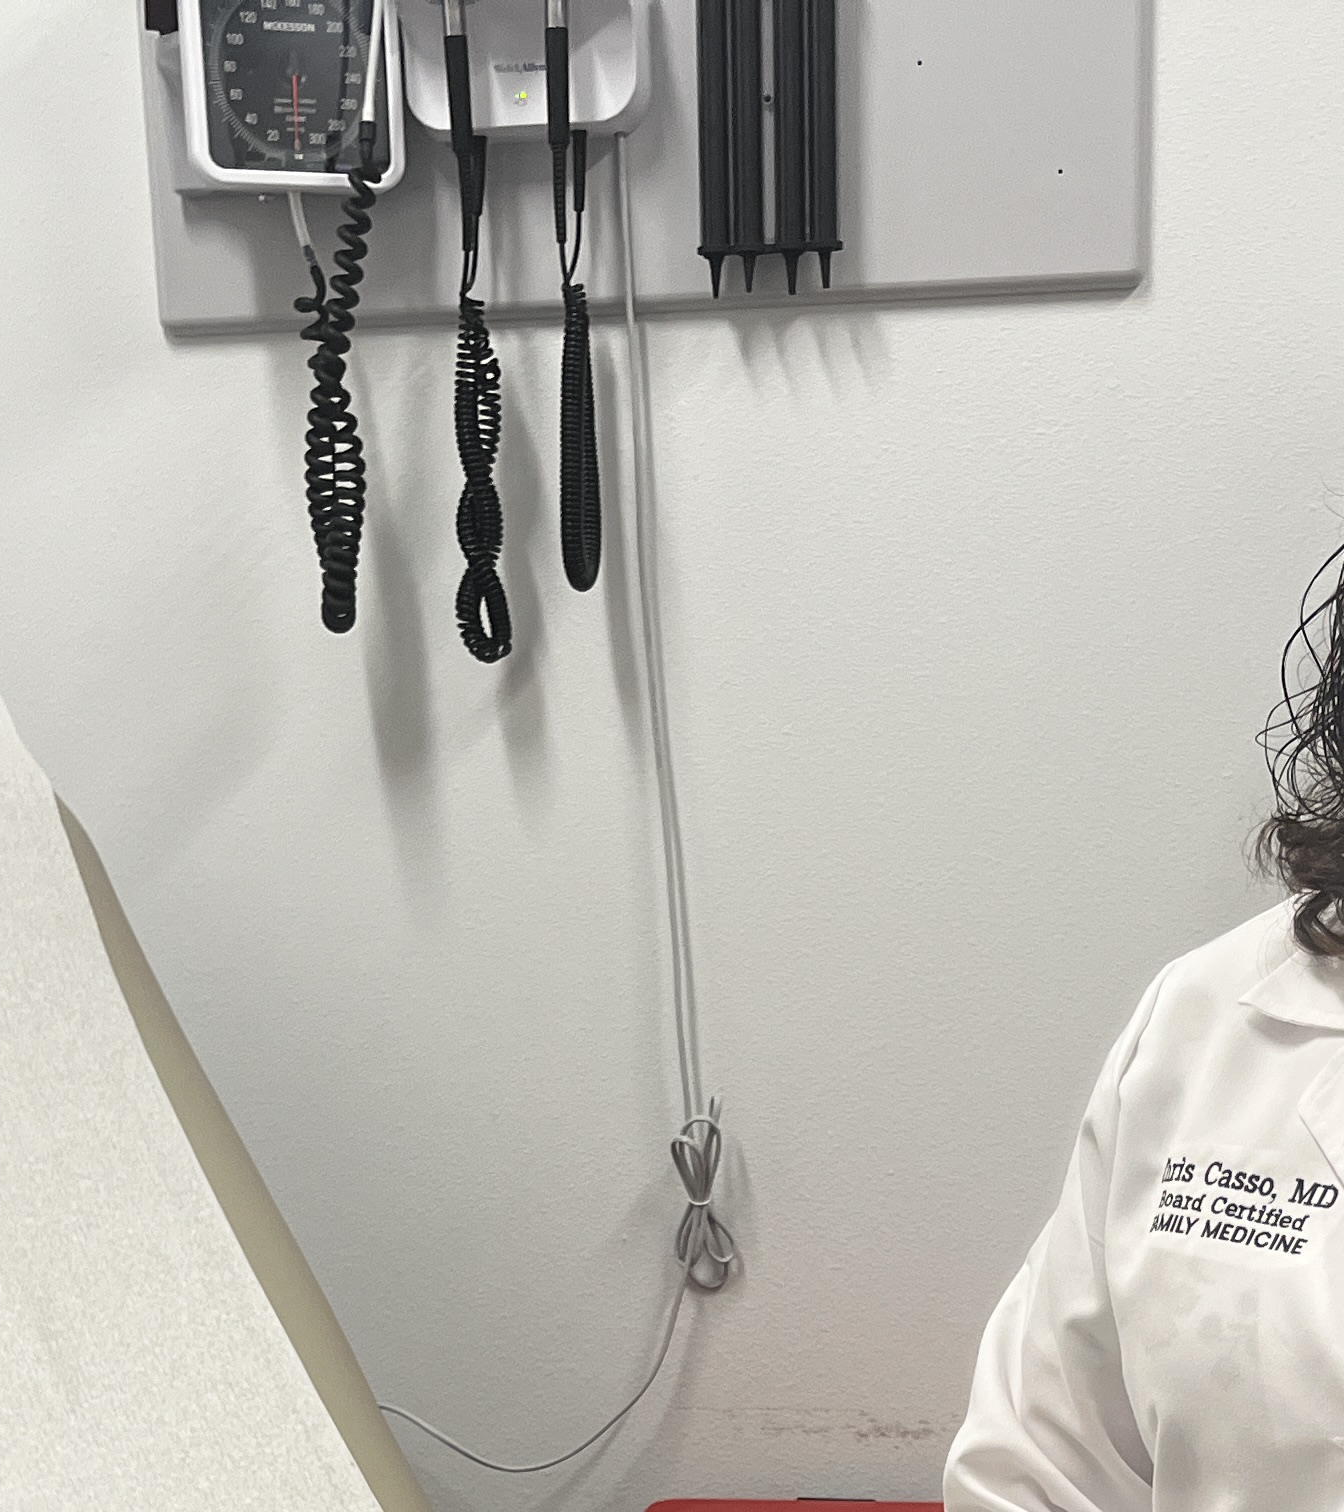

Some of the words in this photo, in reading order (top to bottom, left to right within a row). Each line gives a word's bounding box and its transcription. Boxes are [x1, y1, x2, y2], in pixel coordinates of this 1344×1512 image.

[226, 33, 244, 45] 100
[266, 129, 280, 142] 20
[1204, 1161, 1278, 1204] Casso,
[1288, 1178, 1339, 1210] MD
[1211, 1196, 1310, 1231] Certified
[1149, 1212, 1200, 1235] AMILY
[1201, 1219, 1309, 1255] MEDICINE
